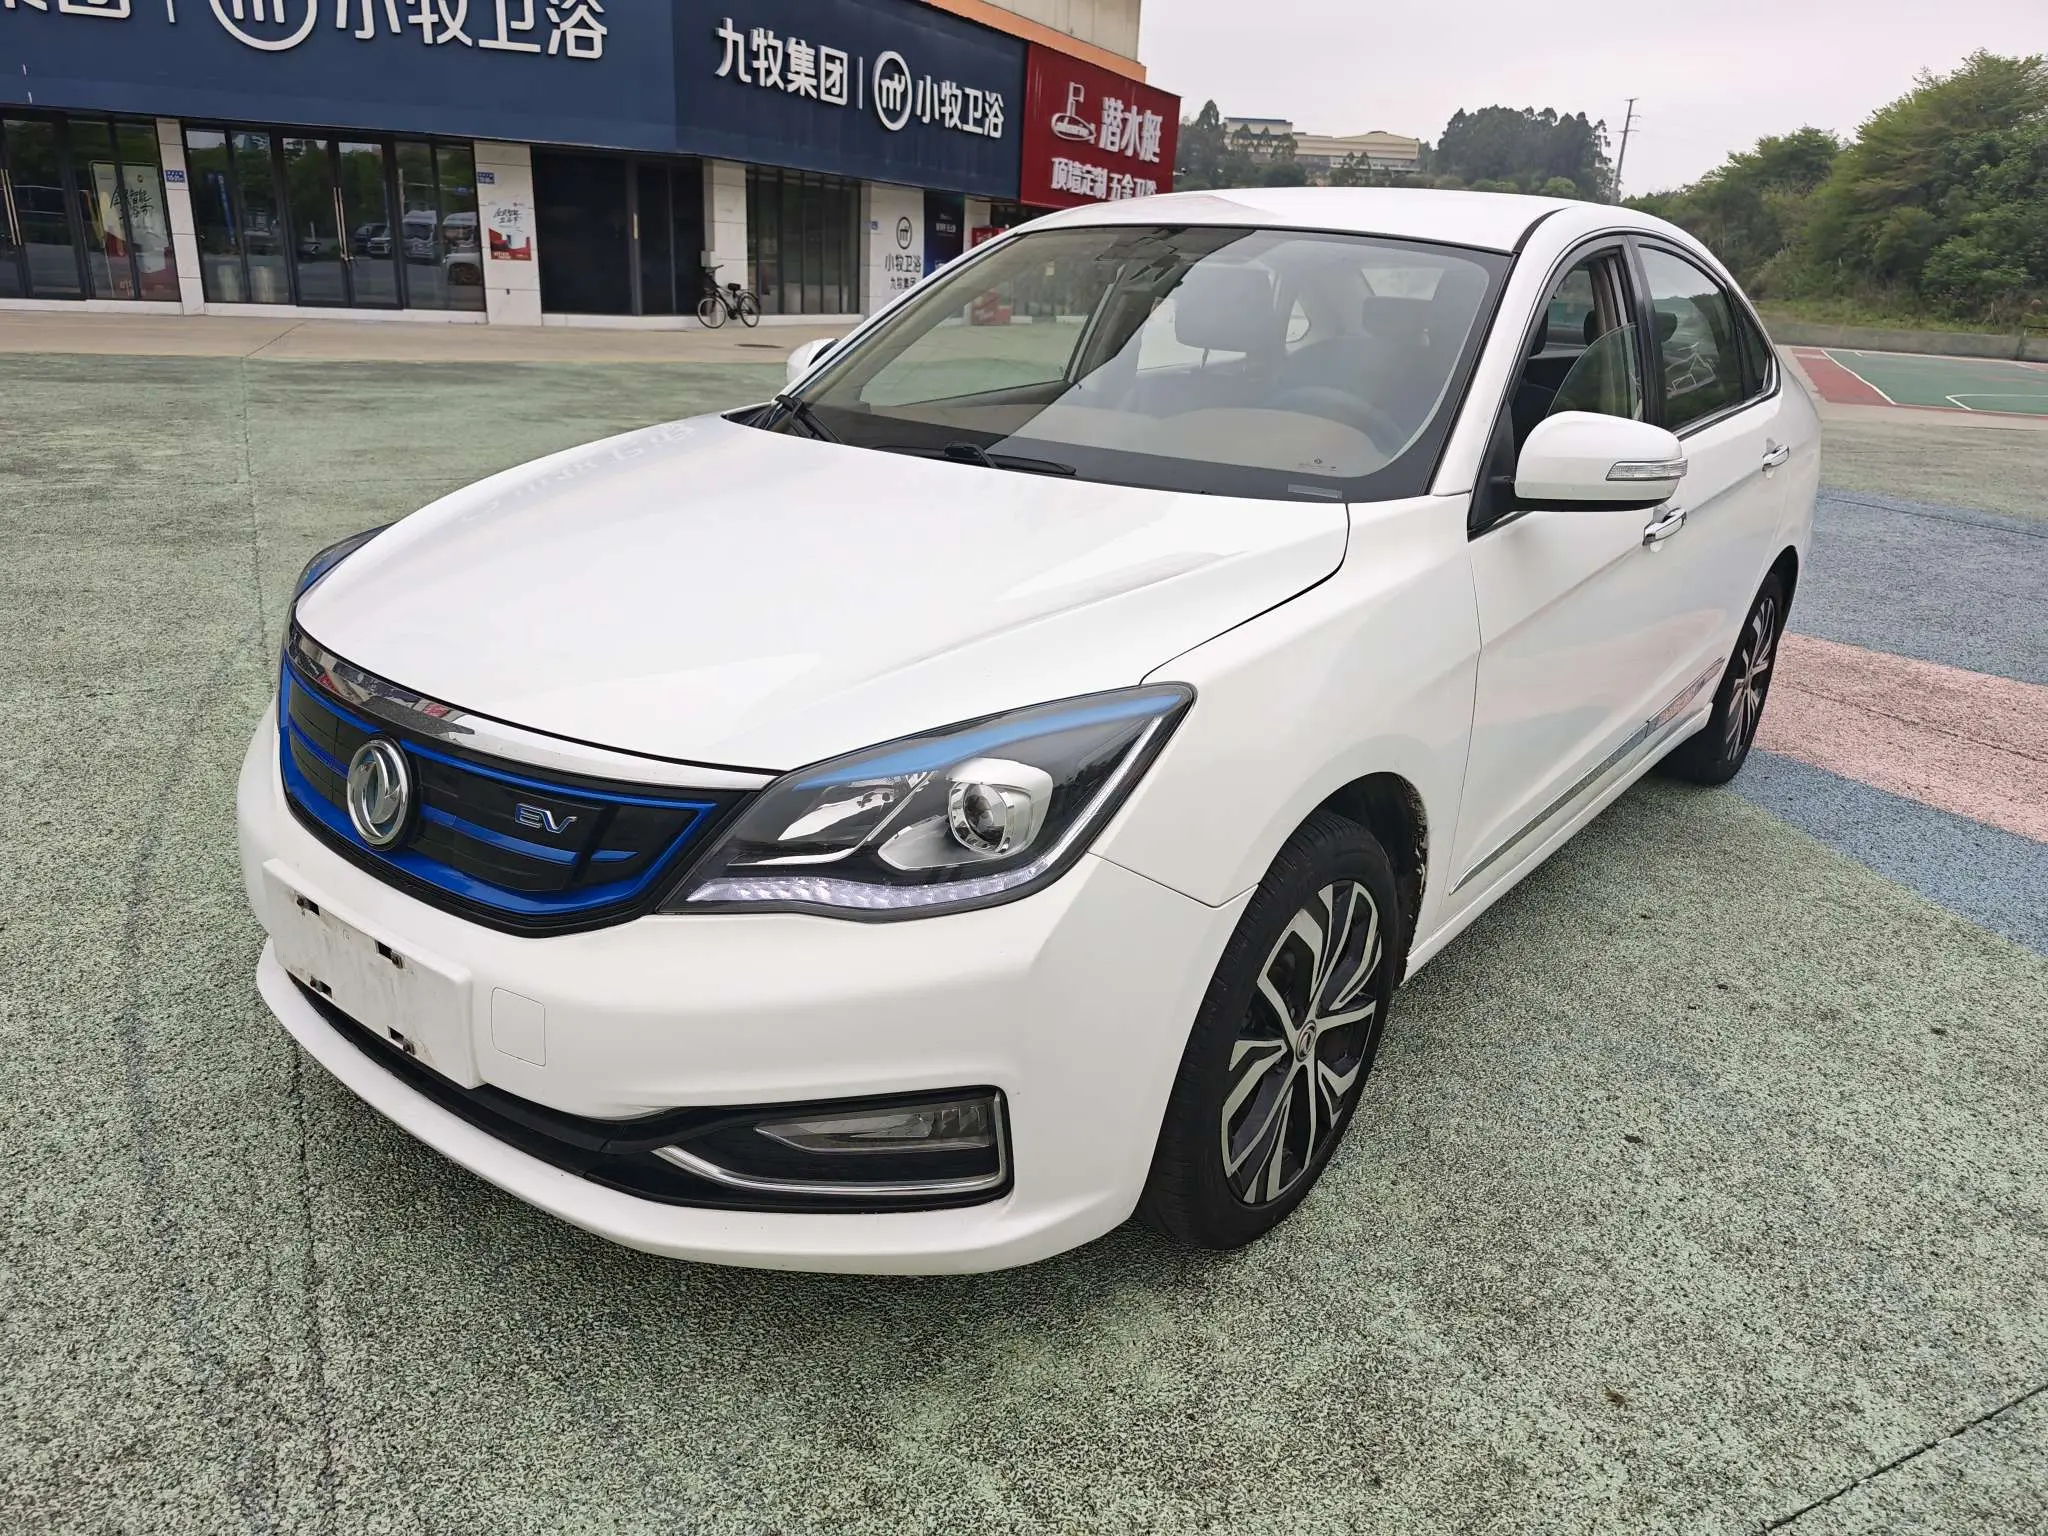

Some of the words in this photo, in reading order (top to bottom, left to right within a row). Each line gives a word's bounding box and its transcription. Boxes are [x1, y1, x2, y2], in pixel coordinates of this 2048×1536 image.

[715, 17, 848, 106] 九牧集团
[915, 75, 1005, 138] 小牧卫浴
[1099, 97, 1163, 163] 潜水艇
[885, 253, 922, 273] 小牧卫浴
[514, 803, 578, 834] EV
